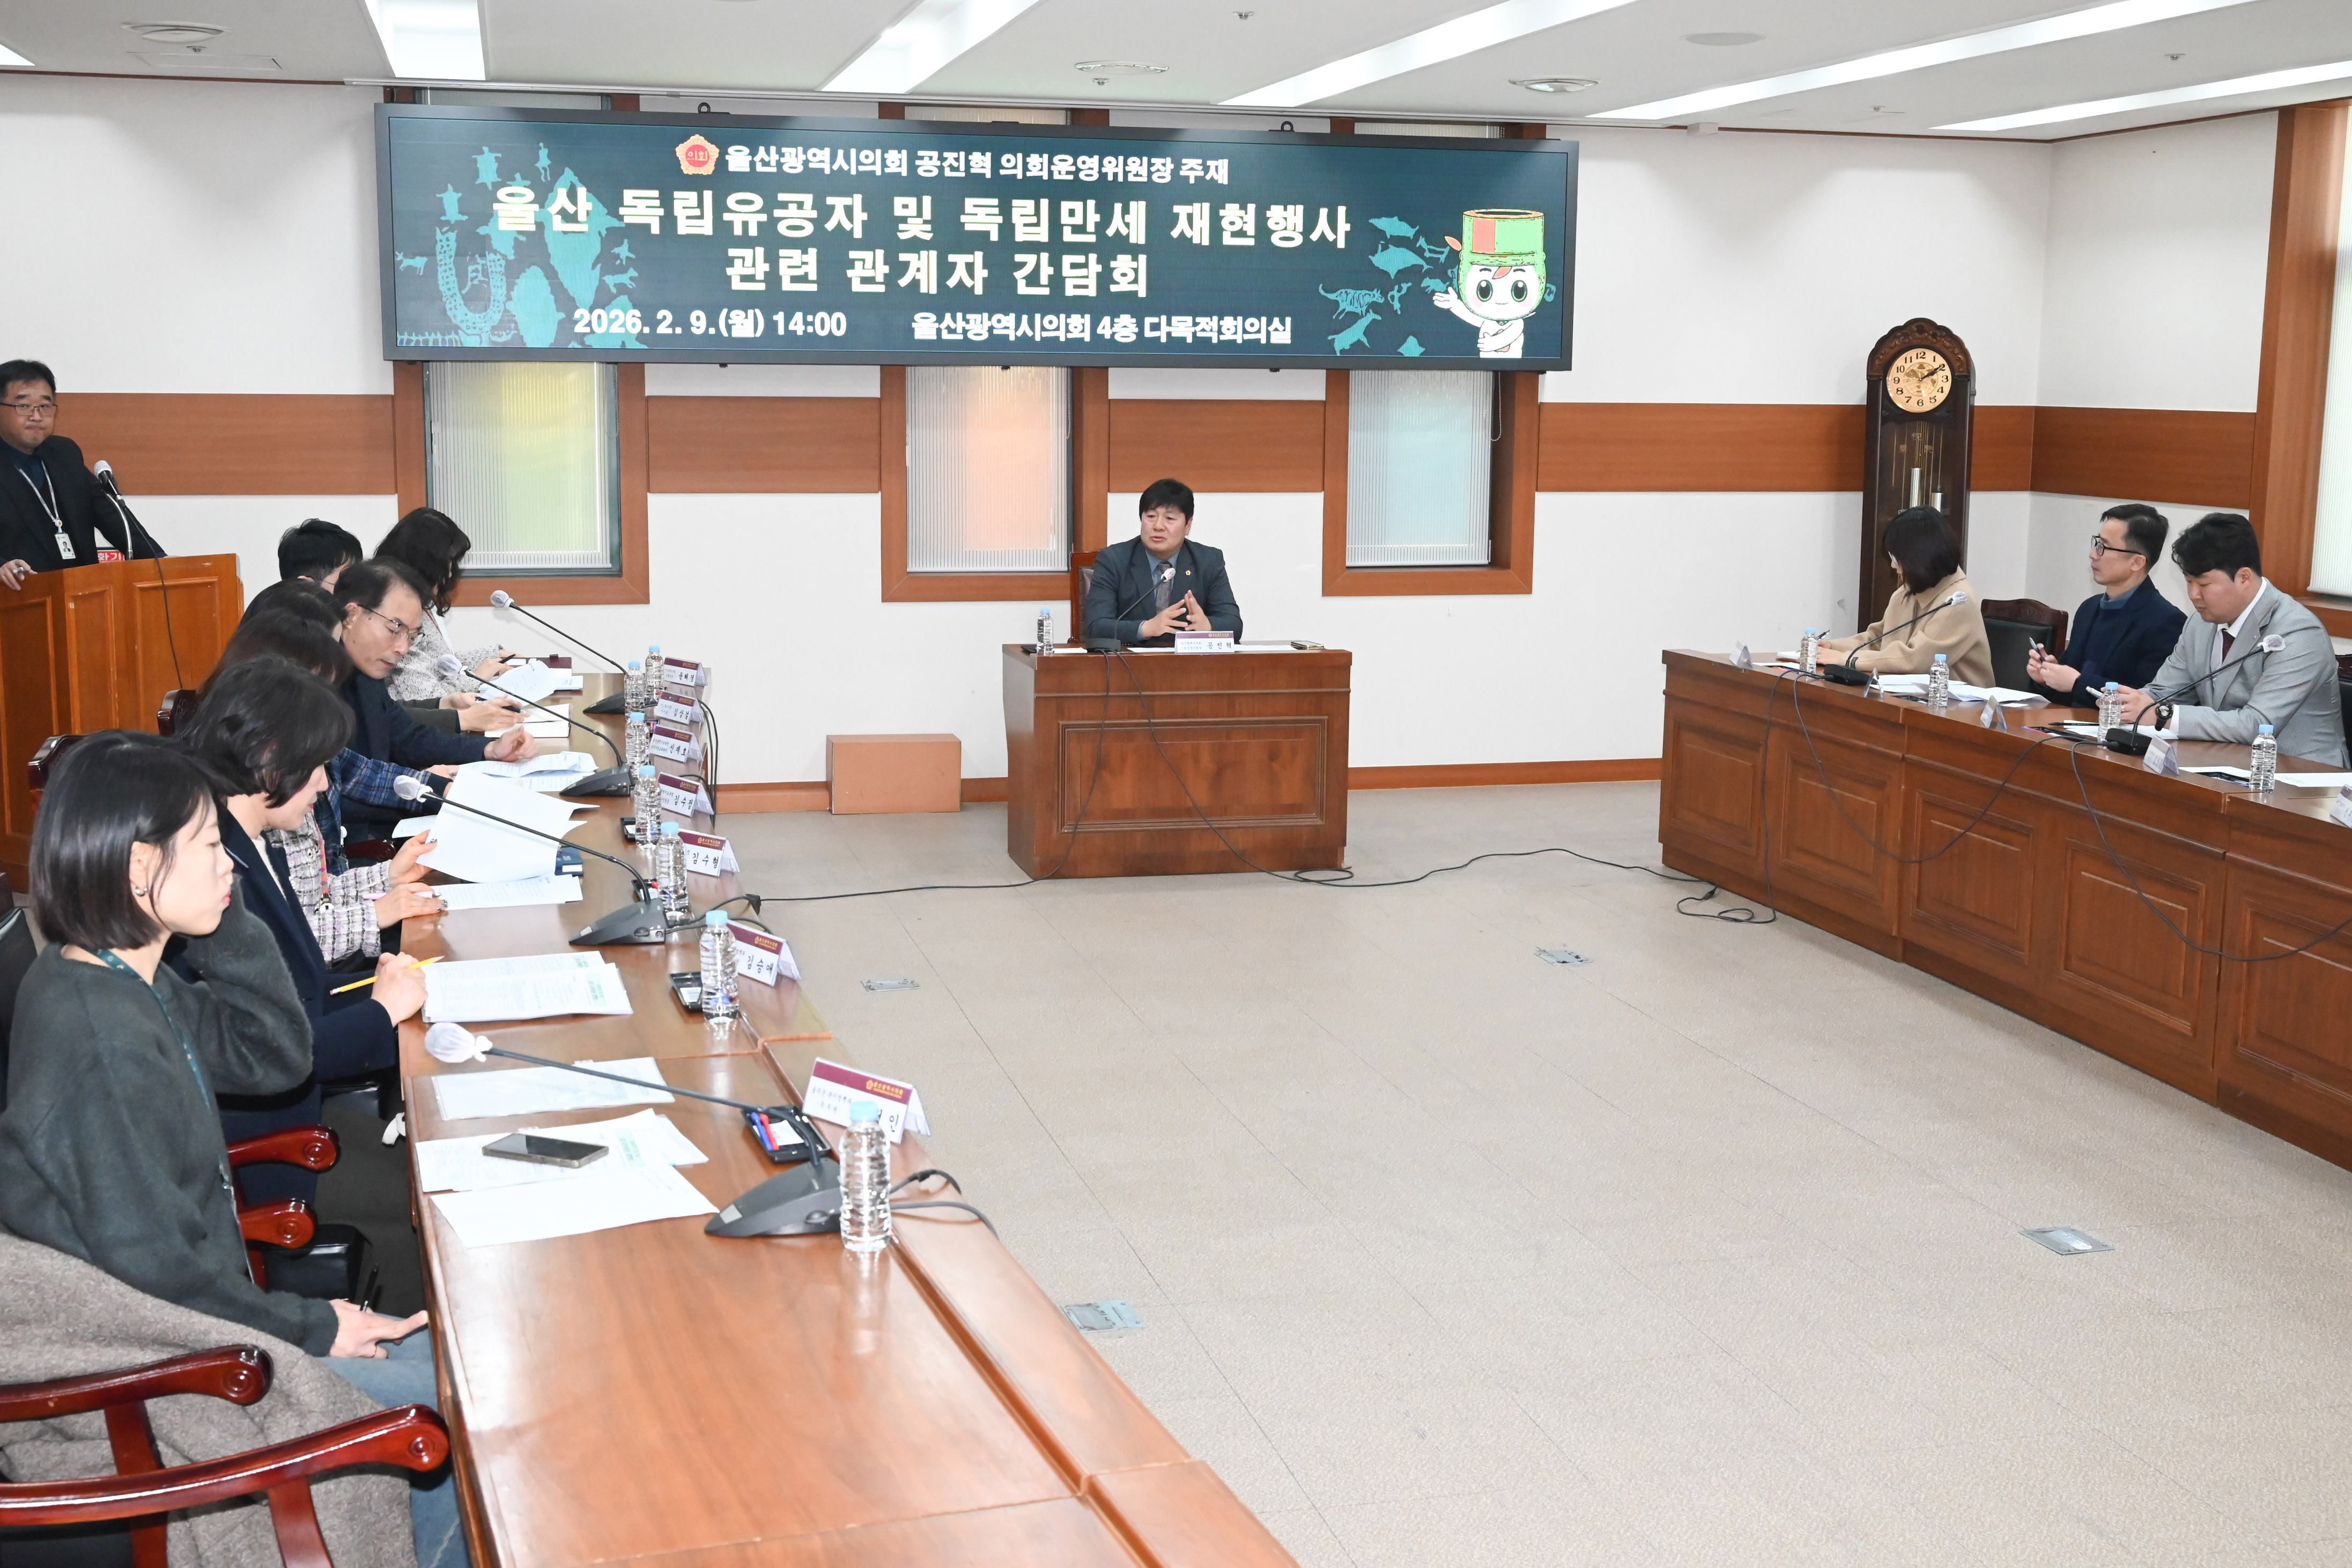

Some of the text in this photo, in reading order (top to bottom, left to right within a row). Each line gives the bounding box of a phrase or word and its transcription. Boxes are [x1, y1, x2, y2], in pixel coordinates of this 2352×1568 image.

[726, 146, 1228, 184] 울산광역시의회 공진혁 의회운영위원장 주재
[493, 186, 1350, 248] 울산 독립유공자 및 독립만세 재현행사
[726, 247, 1147, 297] 관련 관계자 간담회
[773, 312, 846, 336] 14:00
[912, 313, 1291, 344] 울산광역시의회 4층 다목적회의실
[1904, 356, 1913, 364] 11
[1915, 351, 1926, 359] 12
[1896, 365, 1905, 373] 10
[1929, 395, 1937, 403] 5
[98, 553, 121, 561] 화기
[692, 852, 719, 869] 김수형
